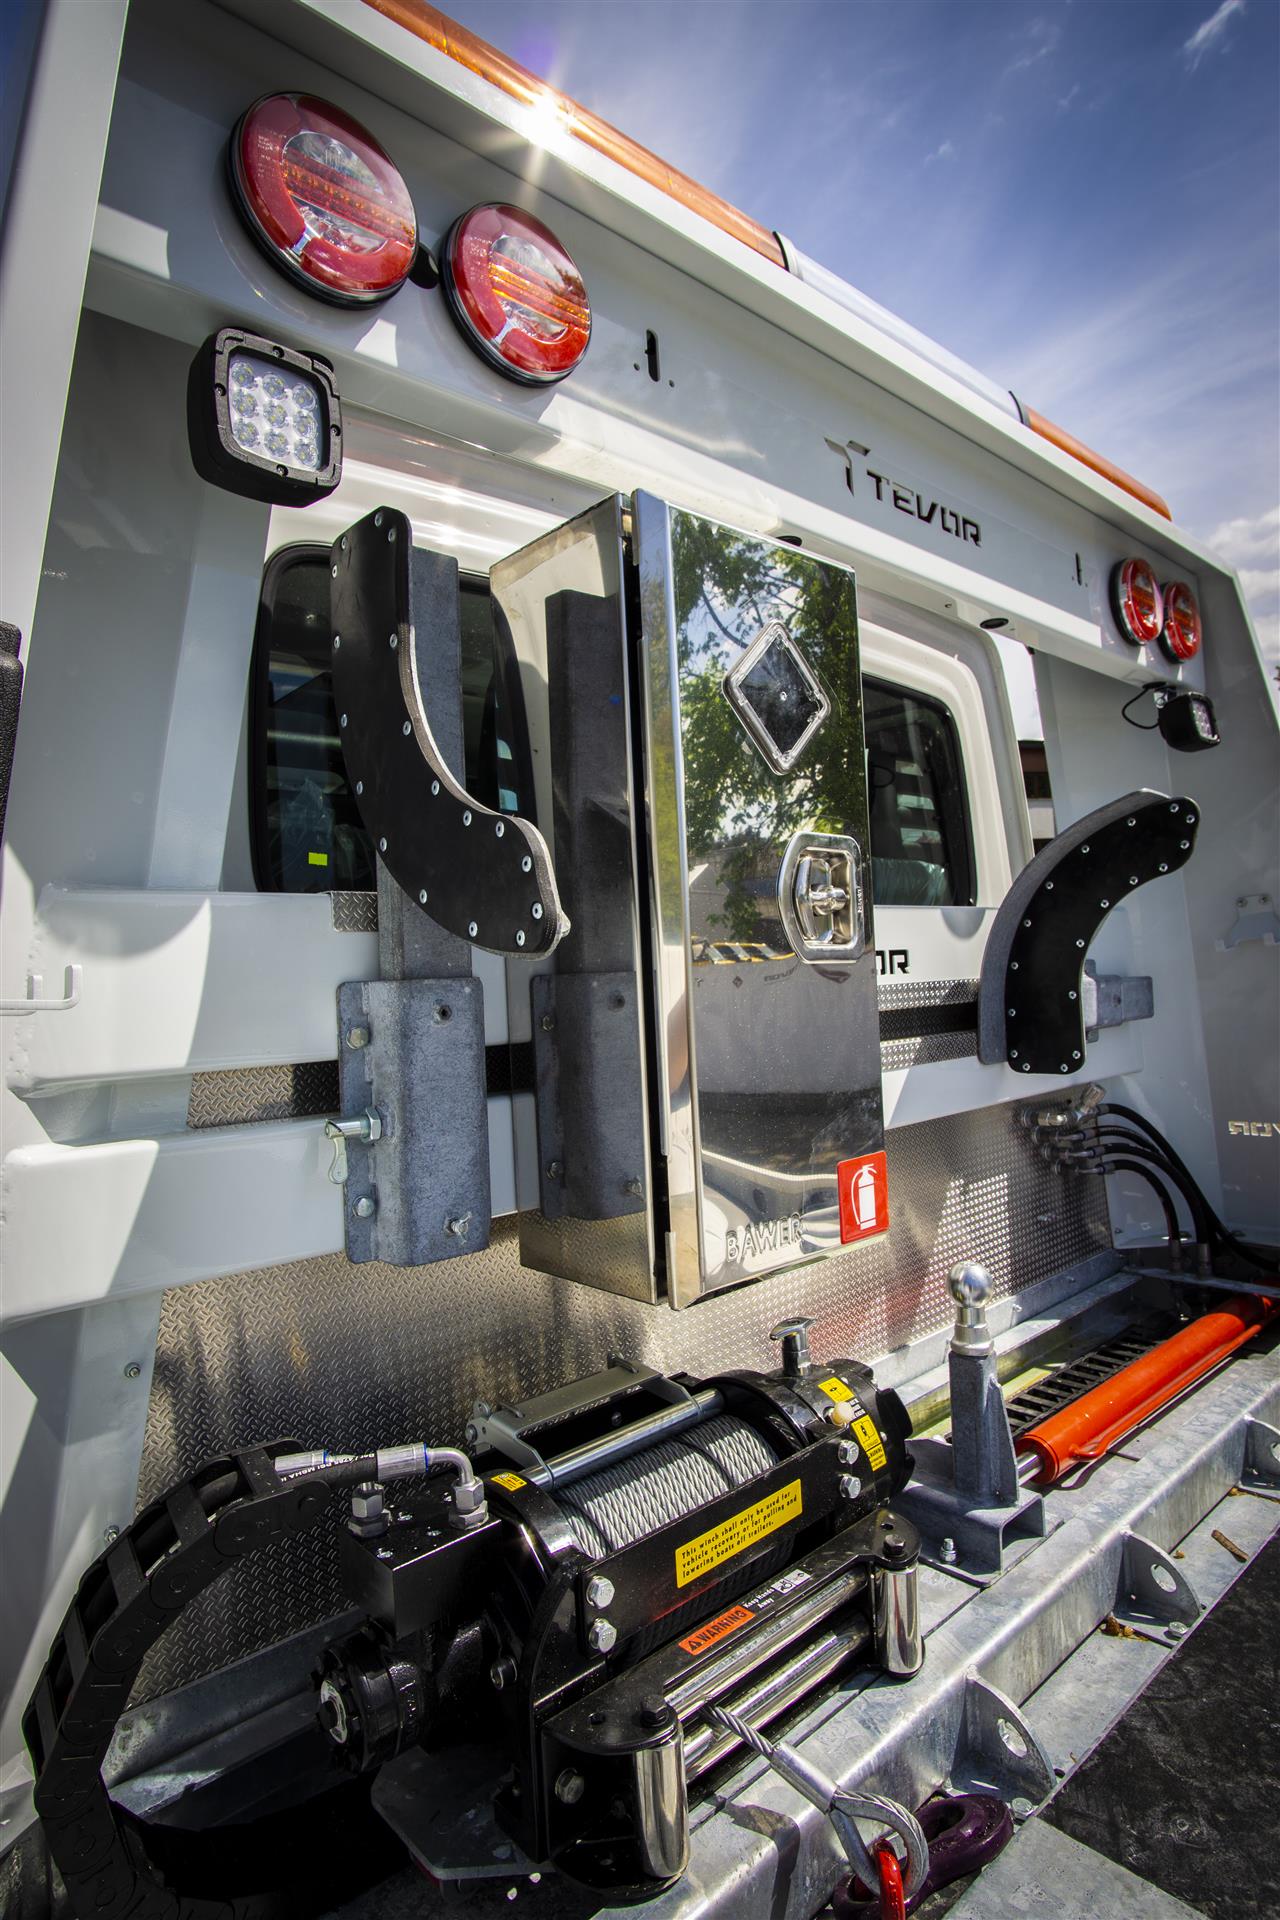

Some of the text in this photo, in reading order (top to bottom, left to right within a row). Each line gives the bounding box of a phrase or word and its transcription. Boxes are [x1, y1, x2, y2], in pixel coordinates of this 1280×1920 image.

[866, 469, 982, 548] TEVOR
[726, 1212, 801, 1263] BAWER
[681, 1547, 697, 1560] This
[699, 1533, 719, 1548] winch
[721, 1521, 738, 1537] shall
[740, 1513, 754, 1526] only
[766, 1497, 780, 1510] used
[682, 1549, 709, 1568] vehicle
[711, 1531, 740, 1552] recovery
[763, 1504, 785, 1521] pulling
[786, 1494, 797, 1507] and
[682, 1556, 714, 1578] lowering
[716, 1543, 735, 1558] boats
[748, 1521, 774, 1539] trailers.
[756, 1588, 775, 1600] Hands
[696, 1609, 748, 1643] WARNING
